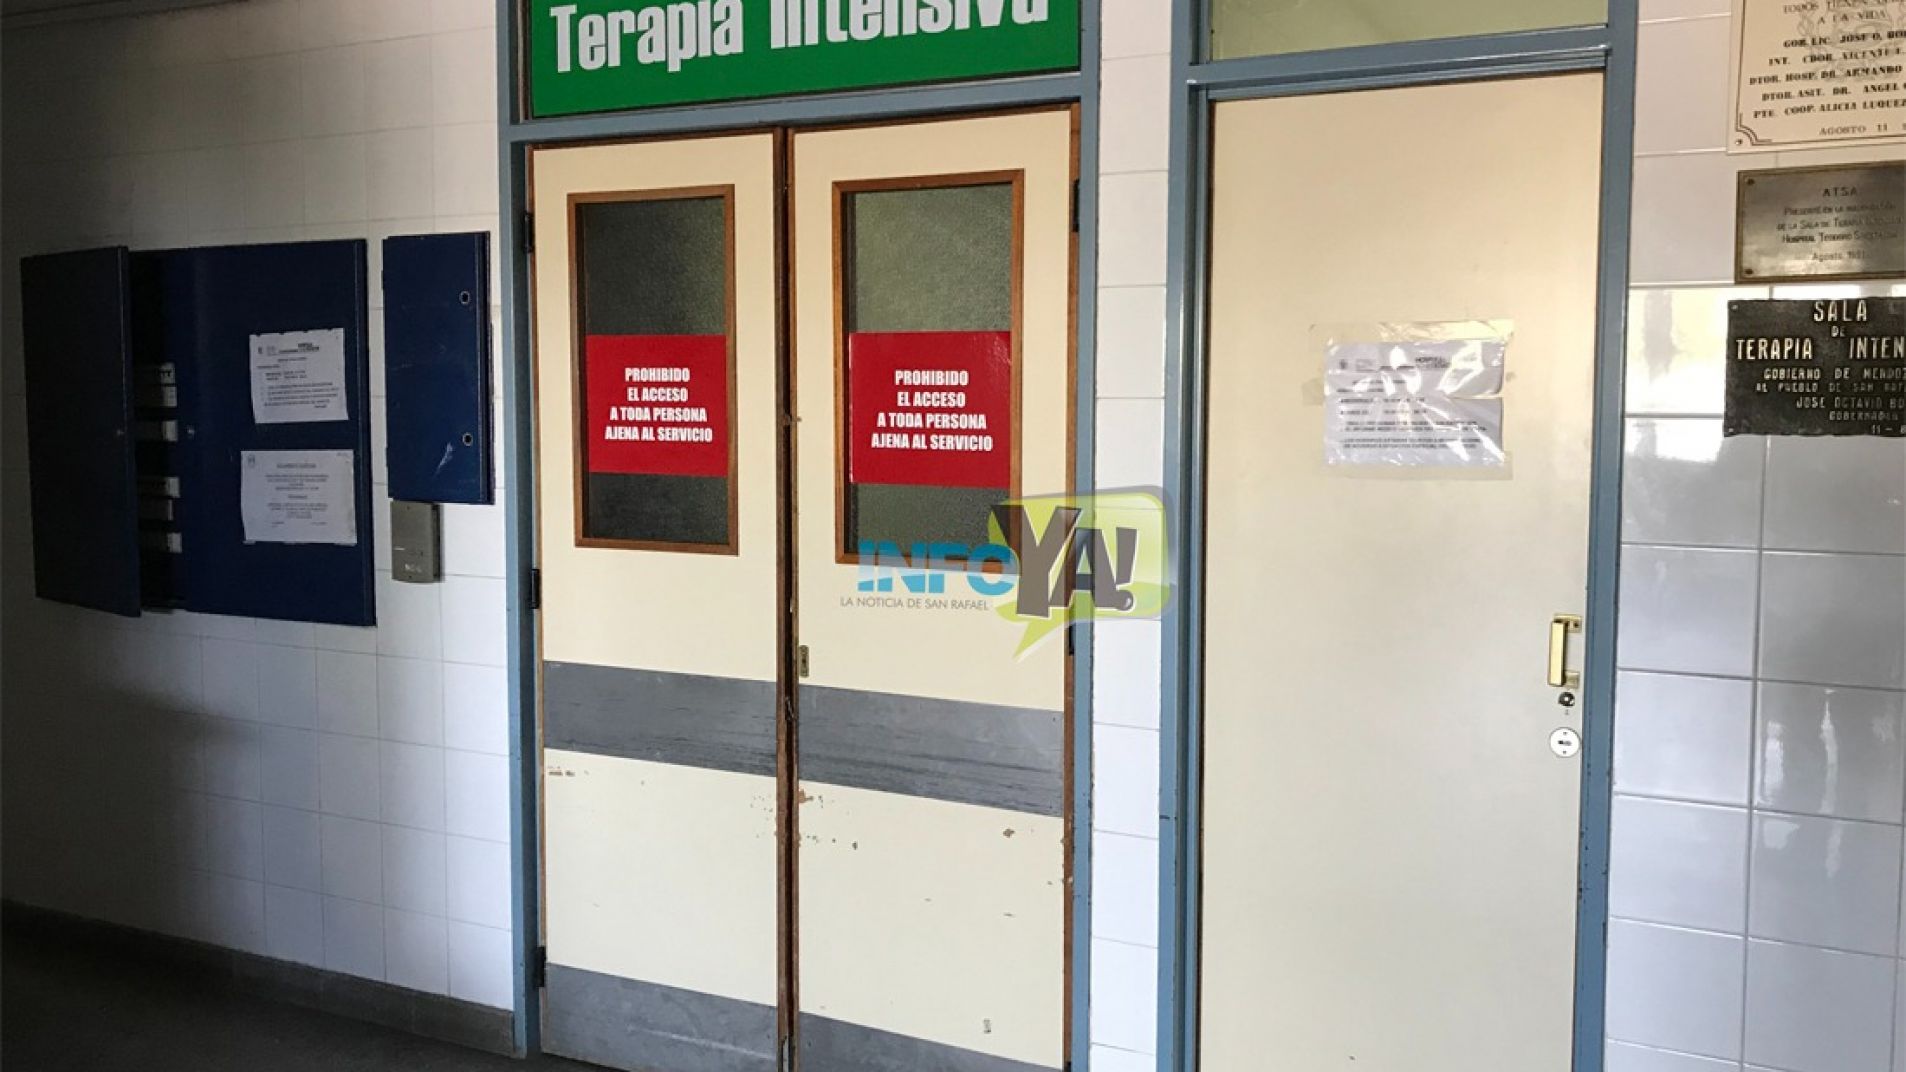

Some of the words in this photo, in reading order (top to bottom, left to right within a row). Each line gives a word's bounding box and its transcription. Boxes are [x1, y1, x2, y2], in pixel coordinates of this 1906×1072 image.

[550, 0, 744, 73] Terapia
[1846, 65, 1903, 77] ARMANDO
[1863, 83, 1899, 93] ANGEL
[1818, 102, 1857, 112] ALICIA
[1818, 125, 1867, 136] AGOSTO
[1822, 186, 1859, 197] ATSA
[1813, 300, 1867, 322] SALA
[1831, 325, 1846, 337] DE
[1736, 338, 1813, 360] TERAPIA
[1849, 337, 1905, 360] INTEN
[624, 367, 690, 383] PROHIBIDO
[894, 370, 969, 386] PROHIBIDO
[1763, 367, 1821, 380] GOBIERNO
[1834, 367, 1850, 379] DE
[627, 387, 640, 402] EL
[642, 387, 689, 402] ACCESO
[1777, 382, 1819, 393] PUEBLO
[1828, 382, 1841, 393] DE
[897, 391, 911, 407] EL
[913, 391, 966, 407] ACCESO
[1796, 397, 1826, 409] JOSE
[1834, 396, 1883, 409] OCTAVIO
[609, 407, 619, 421] A
[620, 407, 651, 421] TODA
[653, 407, 708, 423] PERSONA
[877, 412, 887, 428] A
[889, 412, 923, 428] TODA
[926, 413, 987, 429] PERSONA
[604, 426, 640, 440] AJENA
[641, 426, 656, 441] AL
[657, 427, 713, 442] SERVICIO
[871, 433, 910, 449] AJENA
[912, 434, 928, 450] AL
[930, 435, 993, 452] SERVICIO
